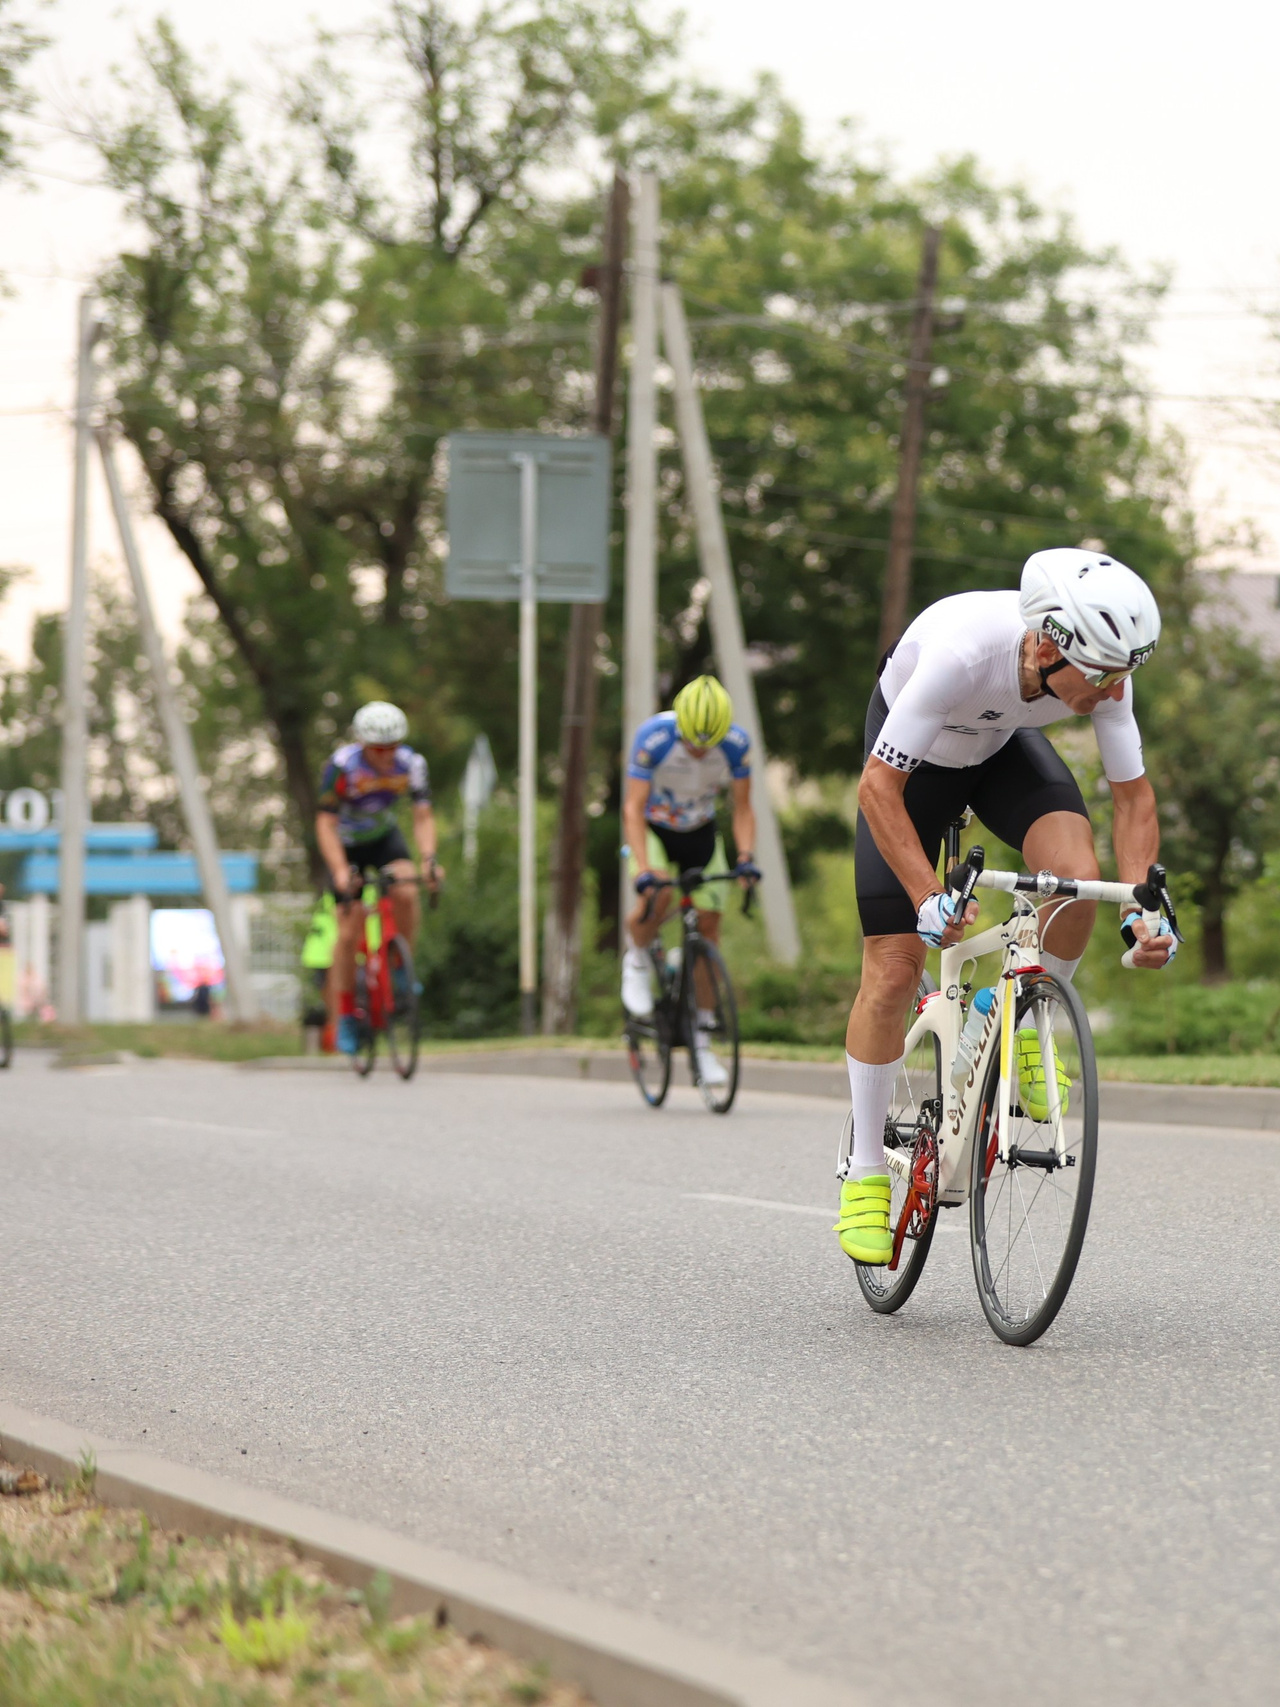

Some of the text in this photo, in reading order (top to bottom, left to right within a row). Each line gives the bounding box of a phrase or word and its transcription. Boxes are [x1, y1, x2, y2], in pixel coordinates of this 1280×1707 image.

[1044, 621, 1068, 647] 300
[876, 748, 915, 772] NEXT
[882, 740, 920, 766] TIME
